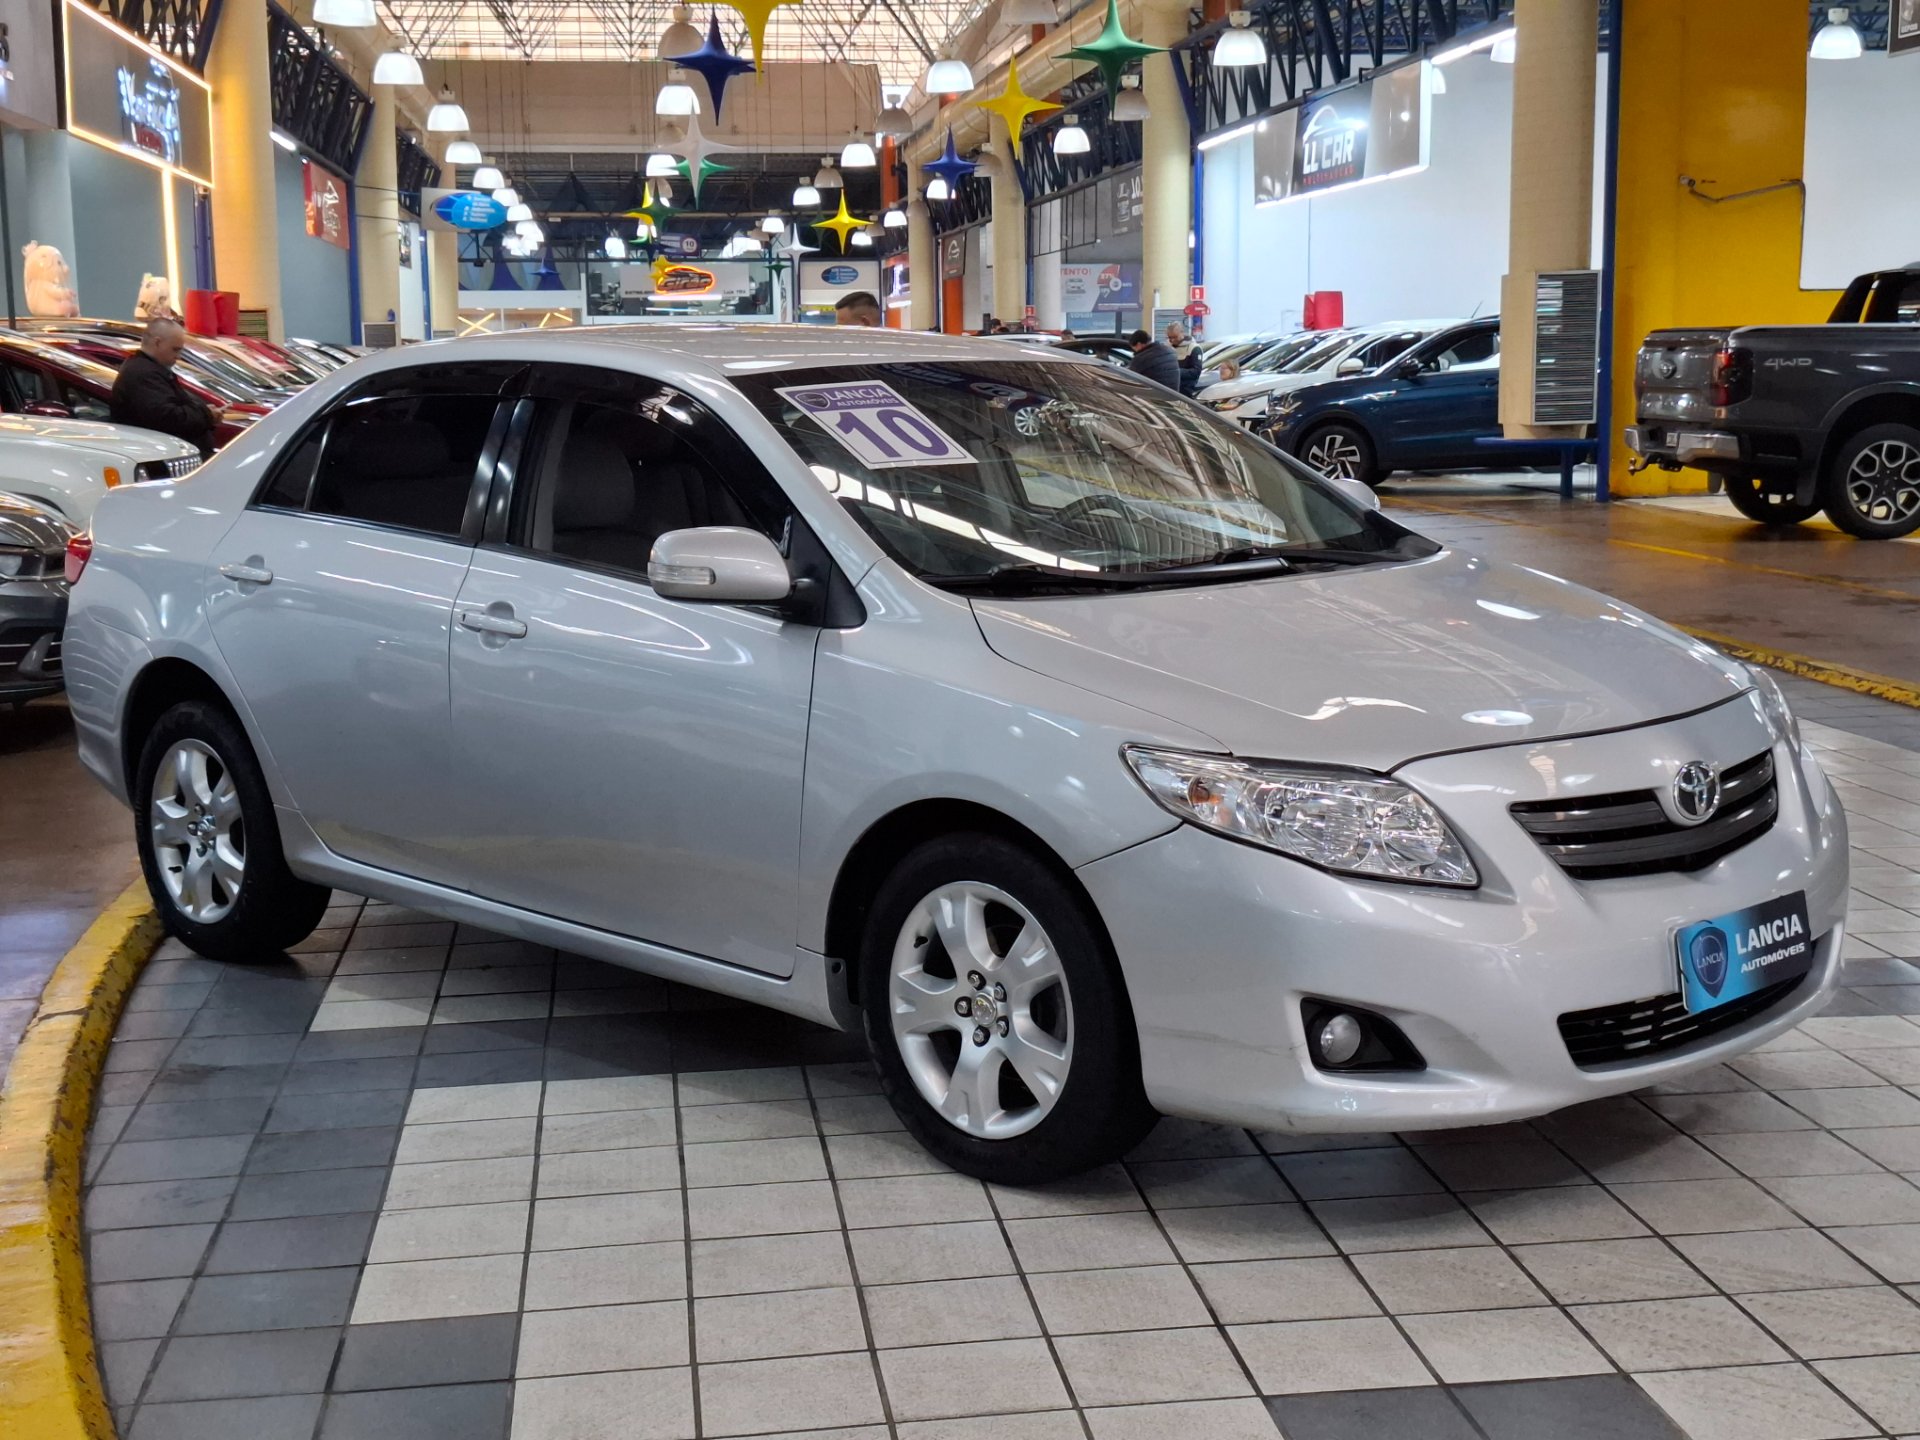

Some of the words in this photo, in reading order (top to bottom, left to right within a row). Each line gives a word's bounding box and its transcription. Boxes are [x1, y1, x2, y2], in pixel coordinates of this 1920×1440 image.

[1303, 141, 1319, 175] LL
[1321, 129, 1356, 170] CAR
[1763, 357, 1813, 370] 4WD
[823, 387, 893, 402] LANCIA
[836, 398, 900, 407] AUTOMÓVEIS
[836, 409, 950, 459] 10
[1735, 913, 1804, 956] LANCIA
[1697, 951, 1725, 969] LANCIA
[1741, 942, 1806, 973] AUTOMÓVEIS
